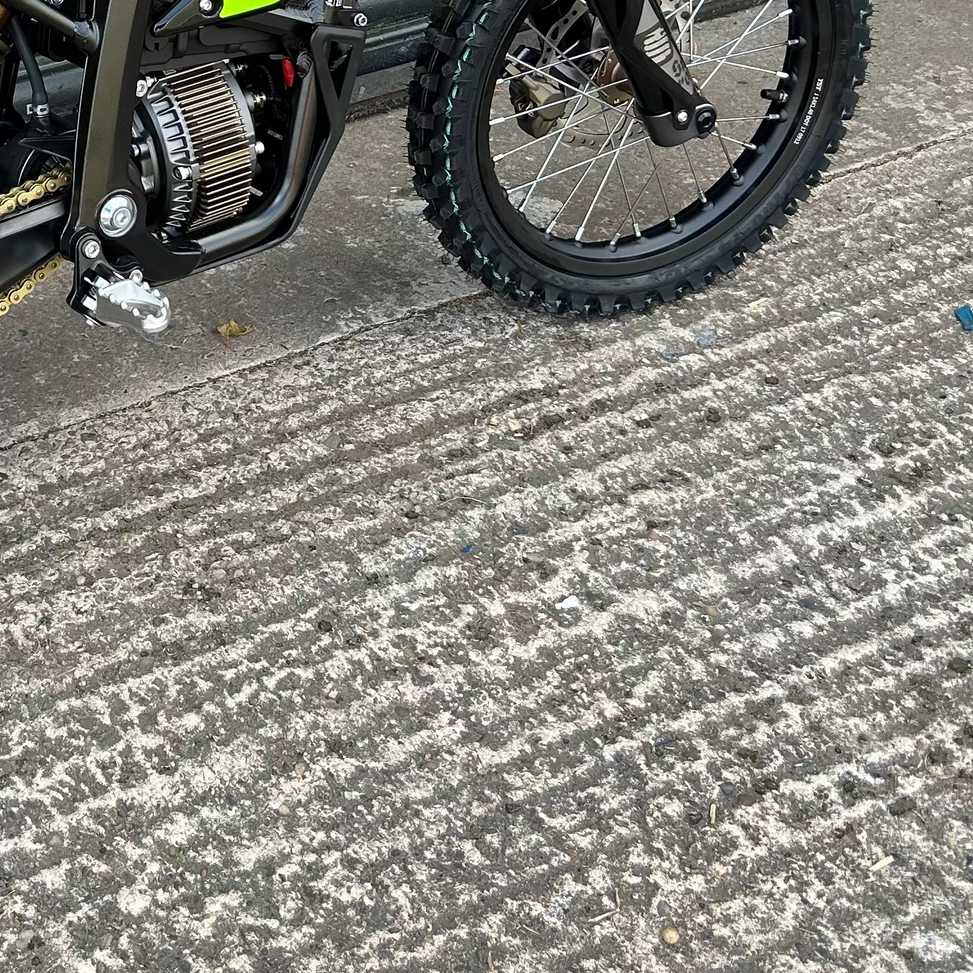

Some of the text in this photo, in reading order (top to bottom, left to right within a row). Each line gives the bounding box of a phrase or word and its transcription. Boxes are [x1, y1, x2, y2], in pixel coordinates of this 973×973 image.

[815, 78, 824, 92] TST
[802, 114, 812, 127] DOT
[800, 126, 807, 134] 17
